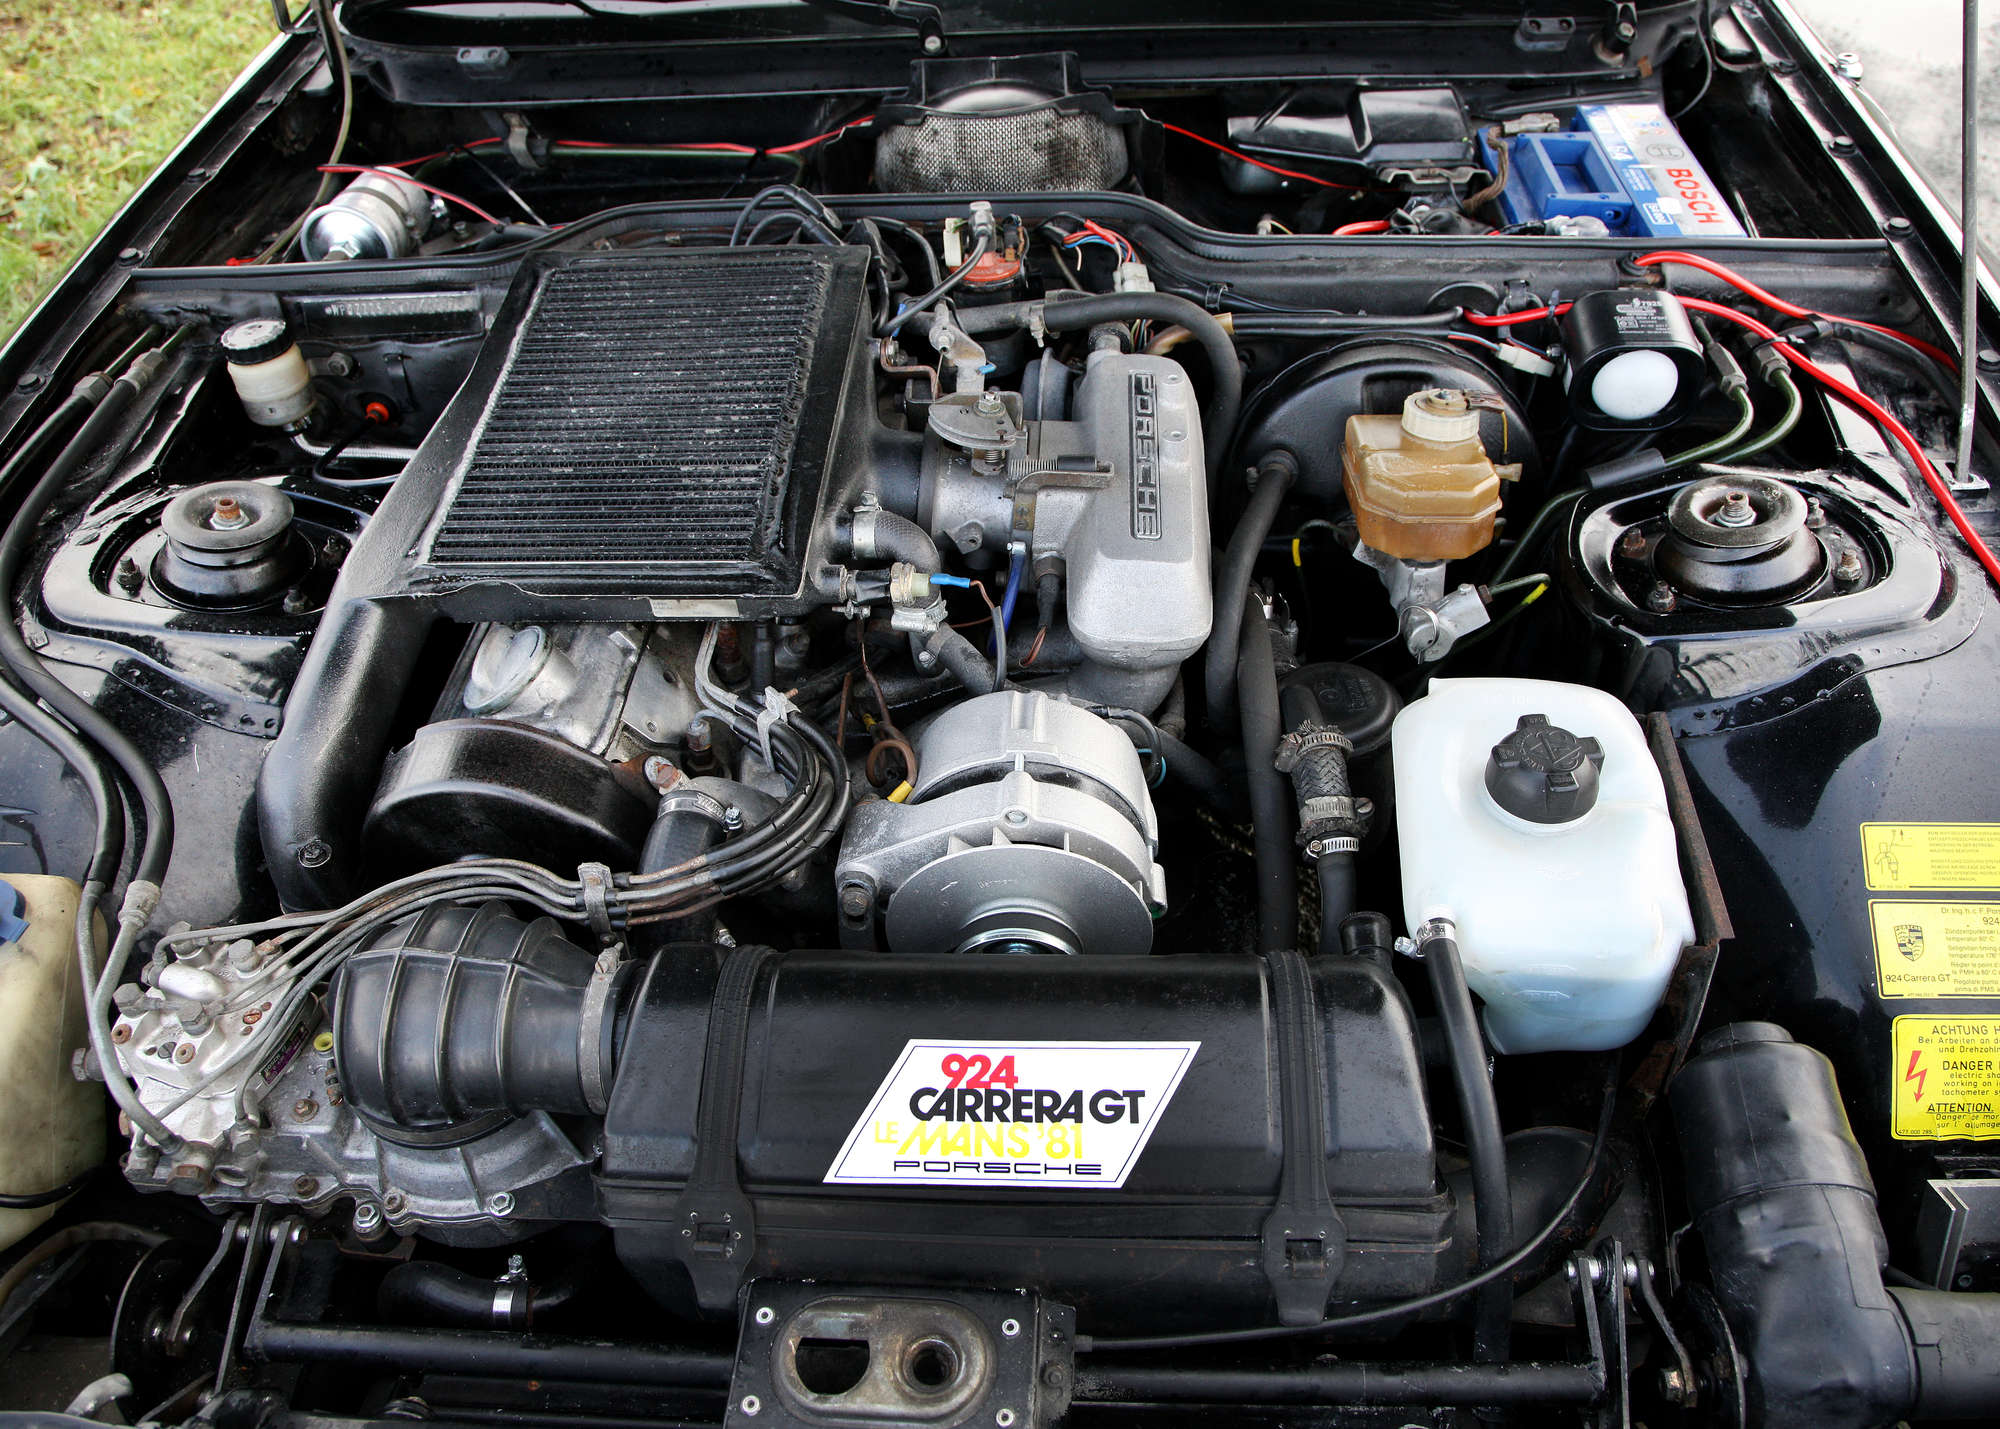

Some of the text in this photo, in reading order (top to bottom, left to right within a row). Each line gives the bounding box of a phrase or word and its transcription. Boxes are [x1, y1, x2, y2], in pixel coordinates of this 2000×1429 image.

[1665, 168, 1725, 223] BOSCH
[1134, 373, 1157, 536] PORSCHE
[1983, 916, 2000, 925] 924
[1885, 973, 1951, 983] 924 Carrera GT
[1932, 1025, 1988, 1035] ACHTUNG
[1918, 1036, 1933, 1044] Bei
[941, 1053, 1018, 1089] 924
[1942, 1061, 1993, 1070] DANGER
[909, 1086, 1146, 1124] CARRERA GT
[875, 1120, 1083, 1159] LE MANS '81
[893, 1161, 1102, 1175] PORSCHE
